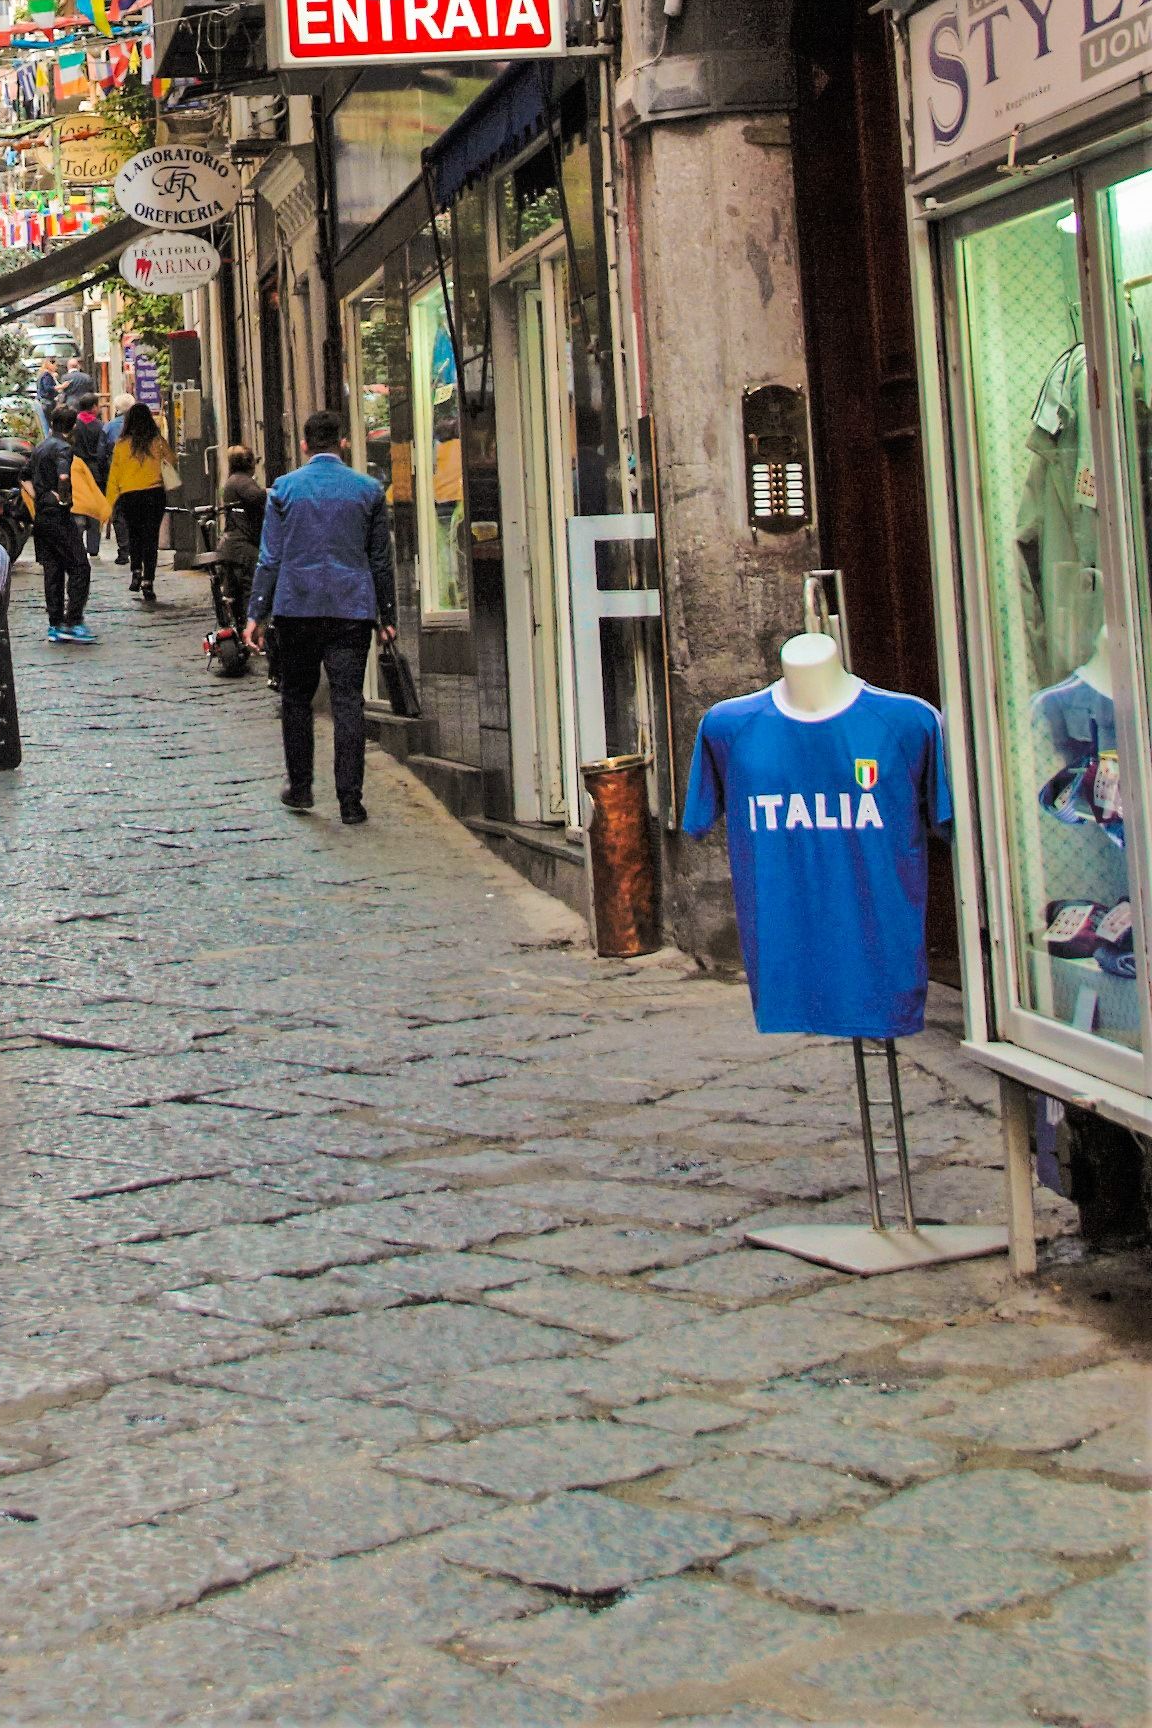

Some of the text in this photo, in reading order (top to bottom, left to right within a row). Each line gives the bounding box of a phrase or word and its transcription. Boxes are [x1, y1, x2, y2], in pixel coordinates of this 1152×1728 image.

[60, 153, 118, 177] Toledo
[123, 149, 229, 183] LABORATORIO
[134, 200, 224, 224] OREFICERIA
[132, 245, 206, 257] TRATTORIA
[747, 792, 885, 832] ITALIA
